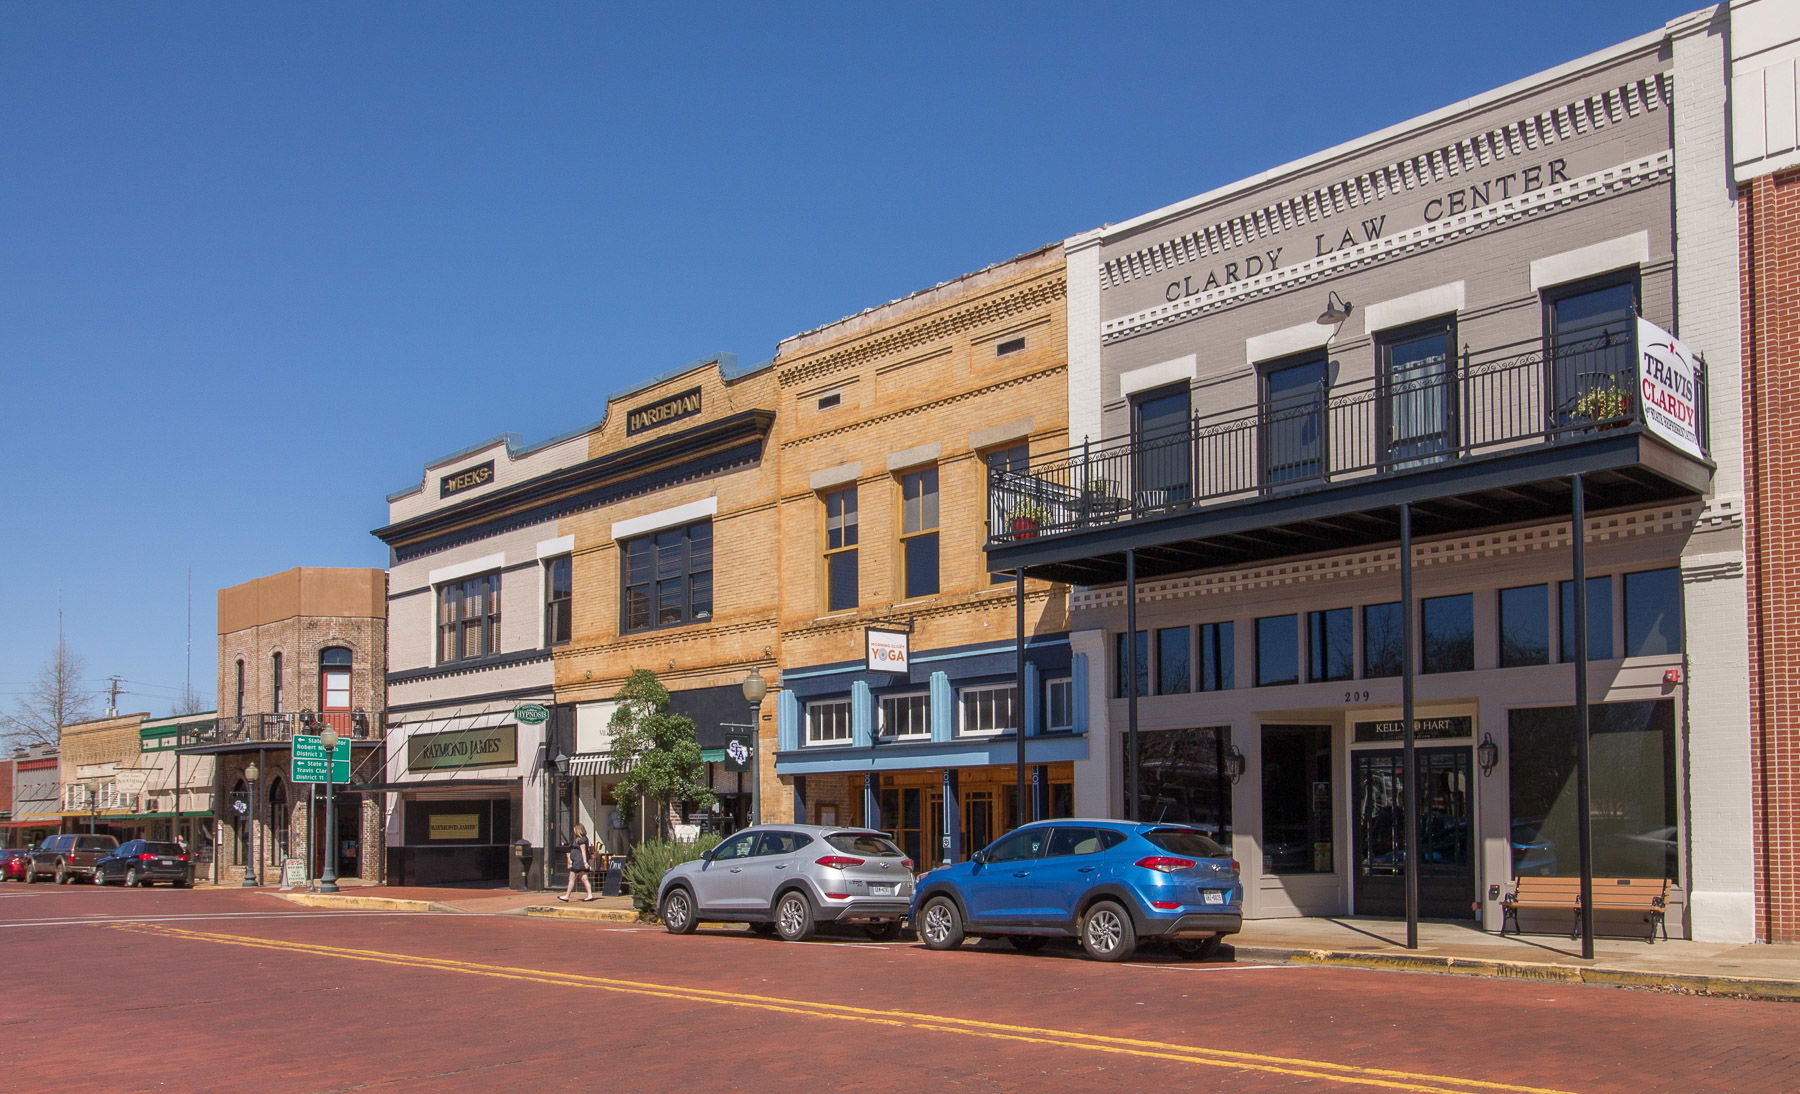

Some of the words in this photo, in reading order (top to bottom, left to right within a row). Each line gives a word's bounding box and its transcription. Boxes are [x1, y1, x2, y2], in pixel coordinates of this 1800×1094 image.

[1165, 247, 1283, 303] CLARDY
[1315, 214, 1387, 258] LAW
[1423, 157, 1572, 224] CENTER
[1643, 351, 1693, 402] TRAVIS
[631, 392, 700, 431] HARDEMAN
[1641, 377, 1694, 428] CLARDY
[449, 467, 489, 492] WEEKS
[871, 648, 905, 661] YOGA
[1344, 690, 1370, 703] 209
[518, 711, 547, 719] HYPNOSIS
[1423, 719, 1451, 731] HART
[422, 742, 468, 760] RAYMOND
[468, 738, 500, 760] JAMES
